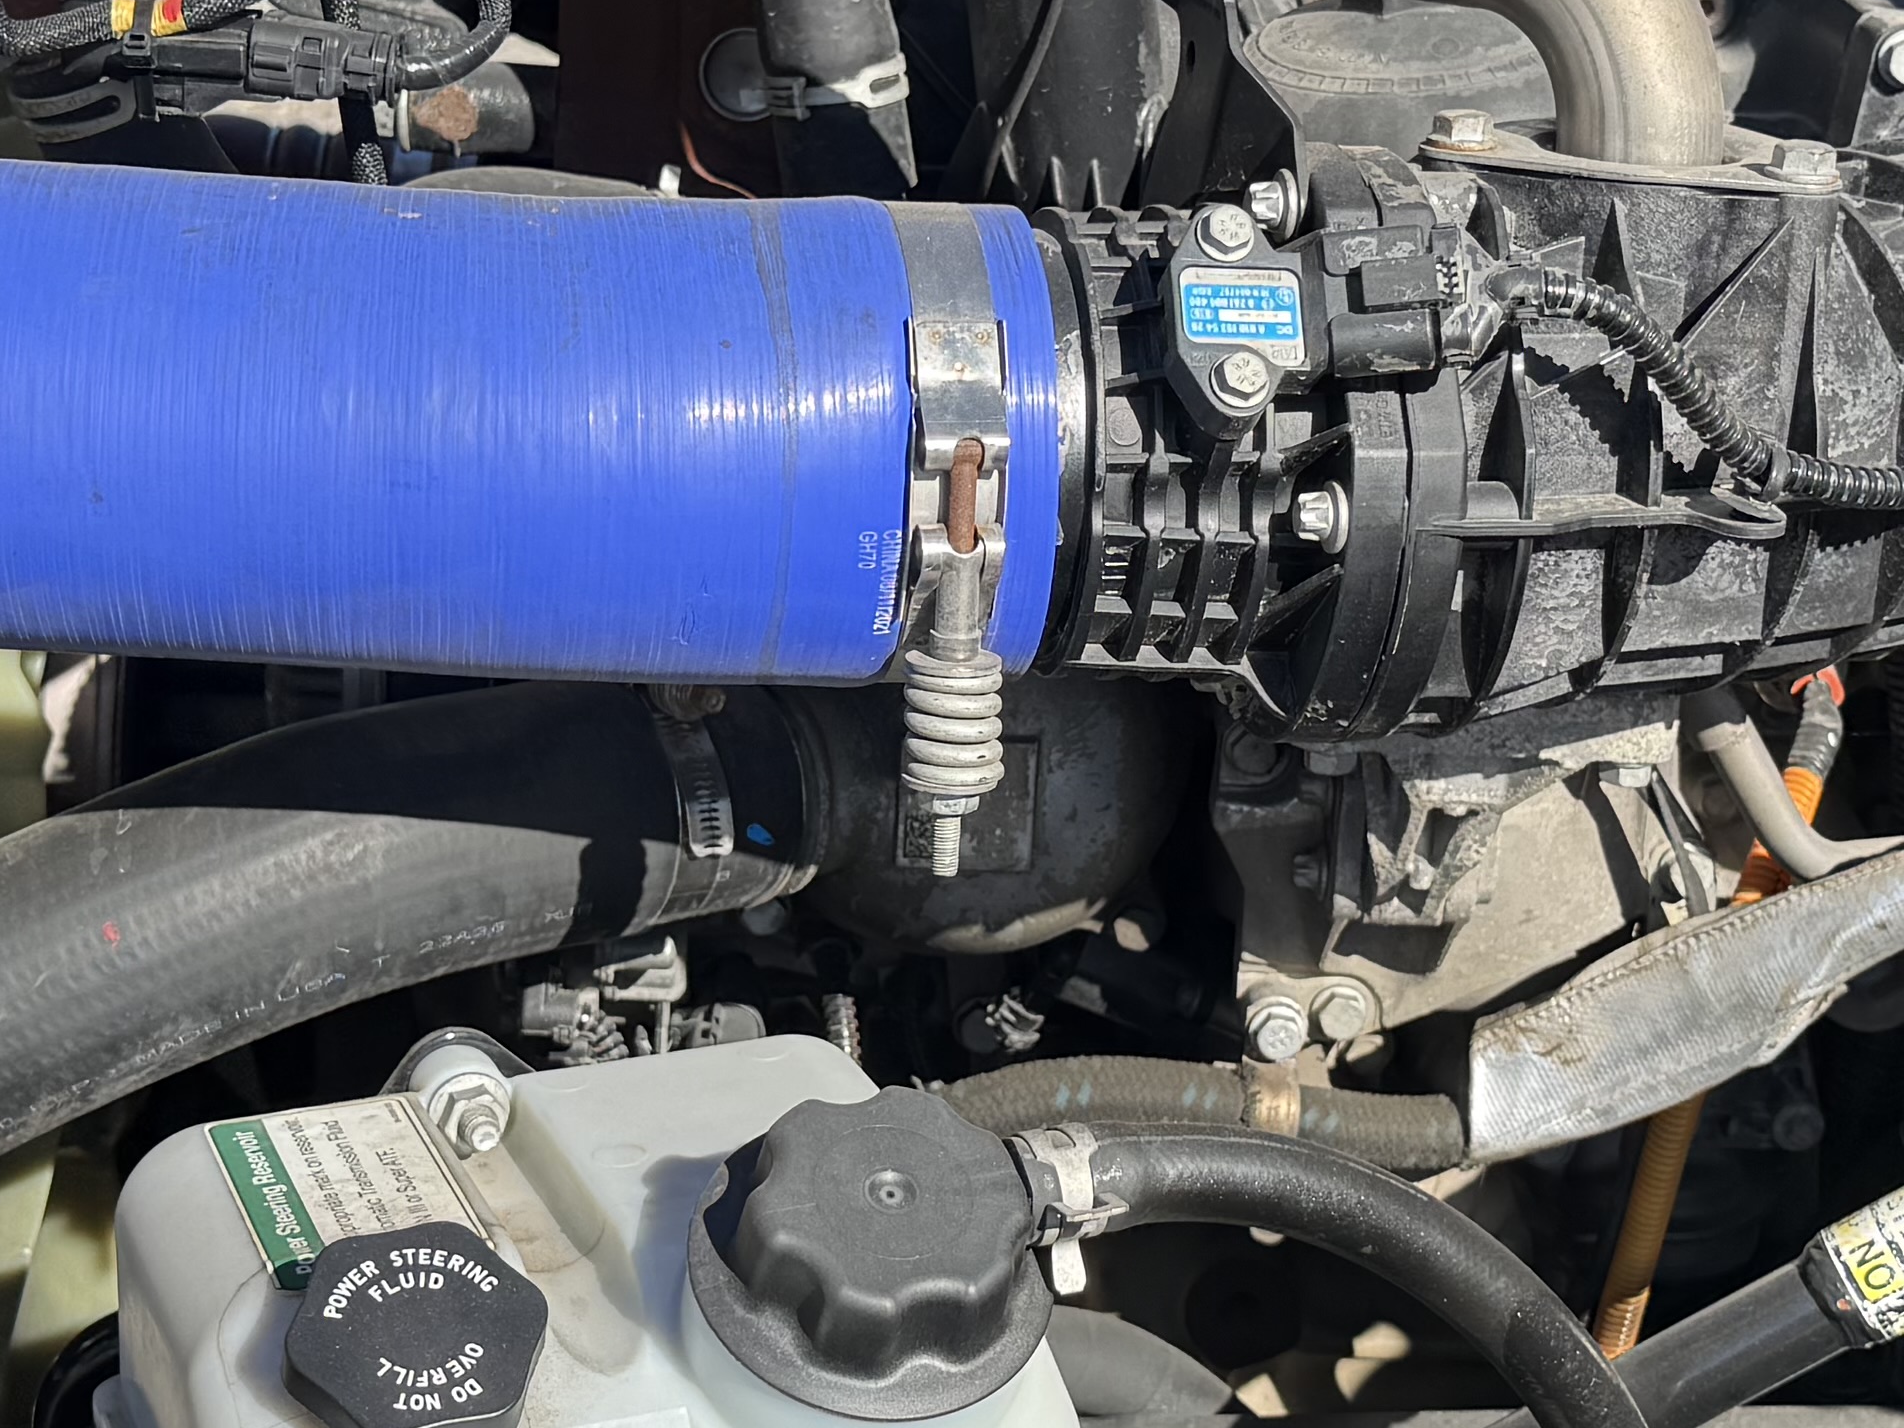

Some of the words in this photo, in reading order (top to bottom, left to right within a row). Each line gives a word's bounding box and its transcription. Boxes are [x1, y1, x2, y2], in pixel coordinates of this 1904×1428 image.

[858, 531, 878, 569] GH70
[881, 530, 902, 573] CHINA
[281, 1116, 315, 1155] reservoir.
[322, 1119, 347, 1142] Fluid
[233, 1130, 278, 1185] Reservoir
[304, 1154, 322, 1169] on
[336, 1136, 377, 1199] Transmission
[375, 1147, 401, 1171] ATF.
[309, 1171, 333, 1192] mark
[392, 1165, 418, 1195] Super
[262, 1183, 301, 1237] Steering
[405, 1193, 422, 1207] or
[323, 1260, 381, 1320] POWER
[389, 1248, 500, 1293] STEERING
[368, 1271, 445, 1303] FLUID
[376, 1342, 485, 1388] OVERFILL
[392, 1393, 443, 1412] NOT
[451, 1378, 485, 1404] DO
